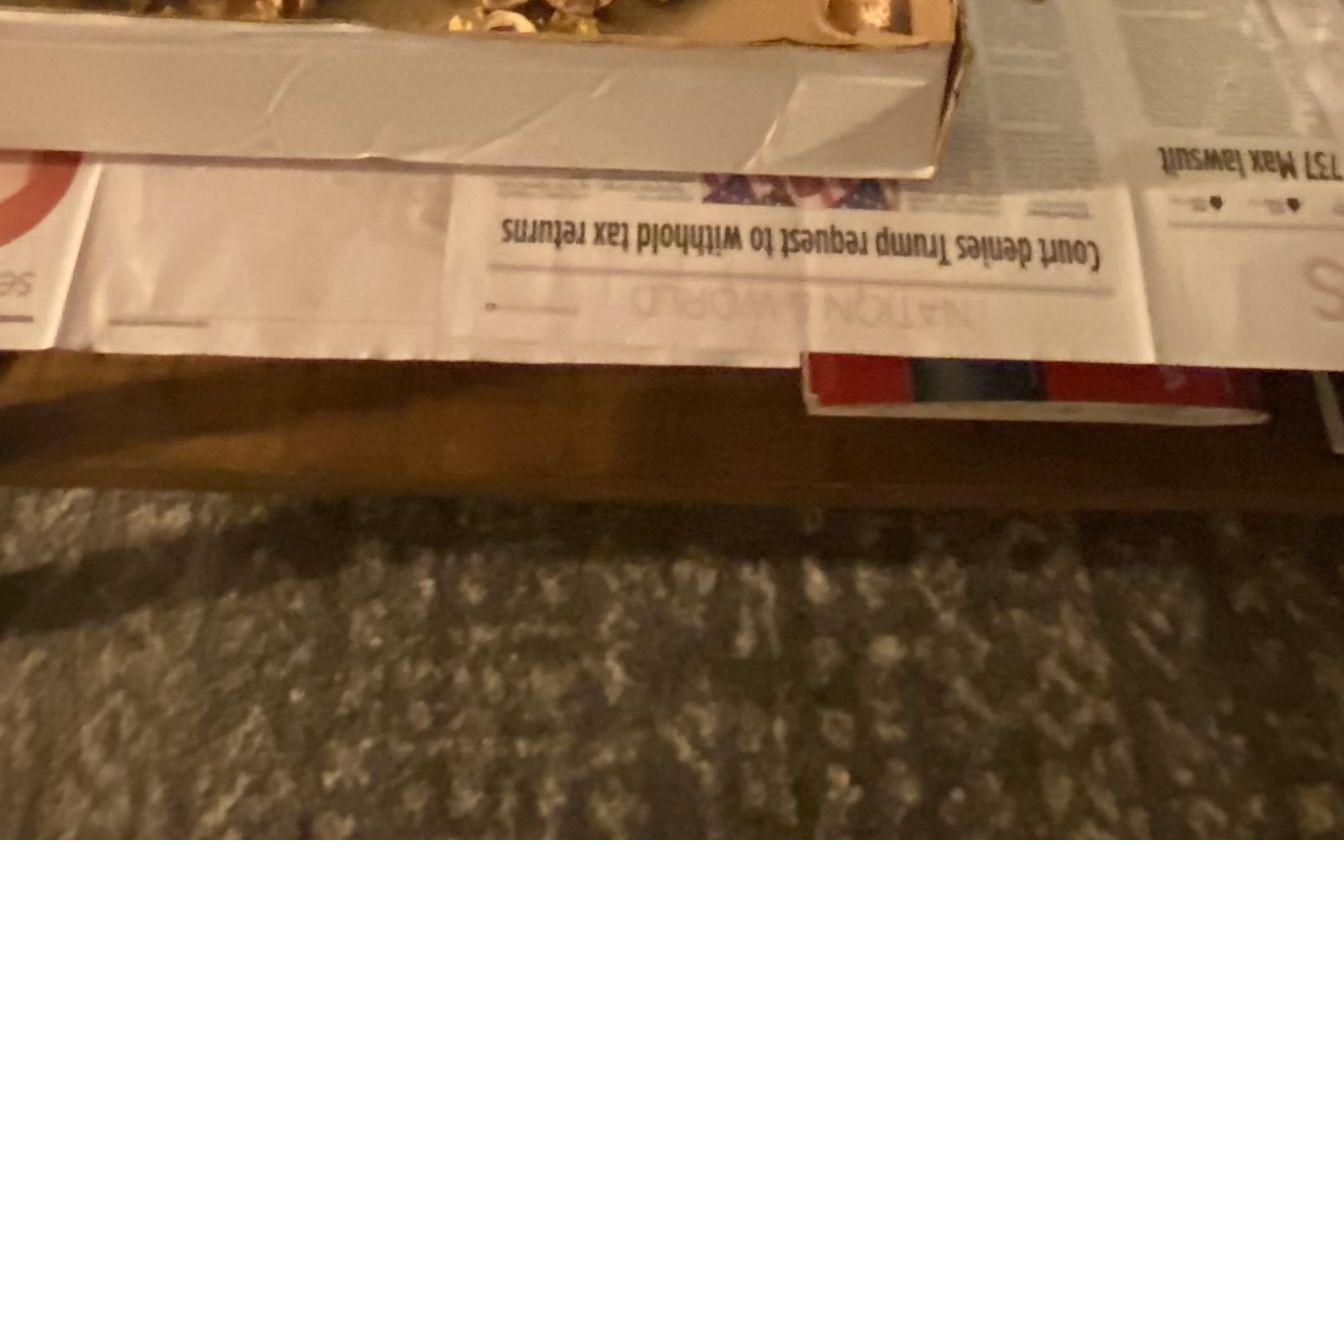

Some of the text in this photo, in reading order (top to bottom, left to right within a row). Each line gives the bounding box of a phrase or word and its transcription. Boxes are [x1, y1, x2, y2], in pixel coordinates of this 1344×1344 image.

[1158, 145, 1344, 183] 737 Max lawsuit
[500, 217, 1102, 272] Court denies Trump request to withhold tax returns
